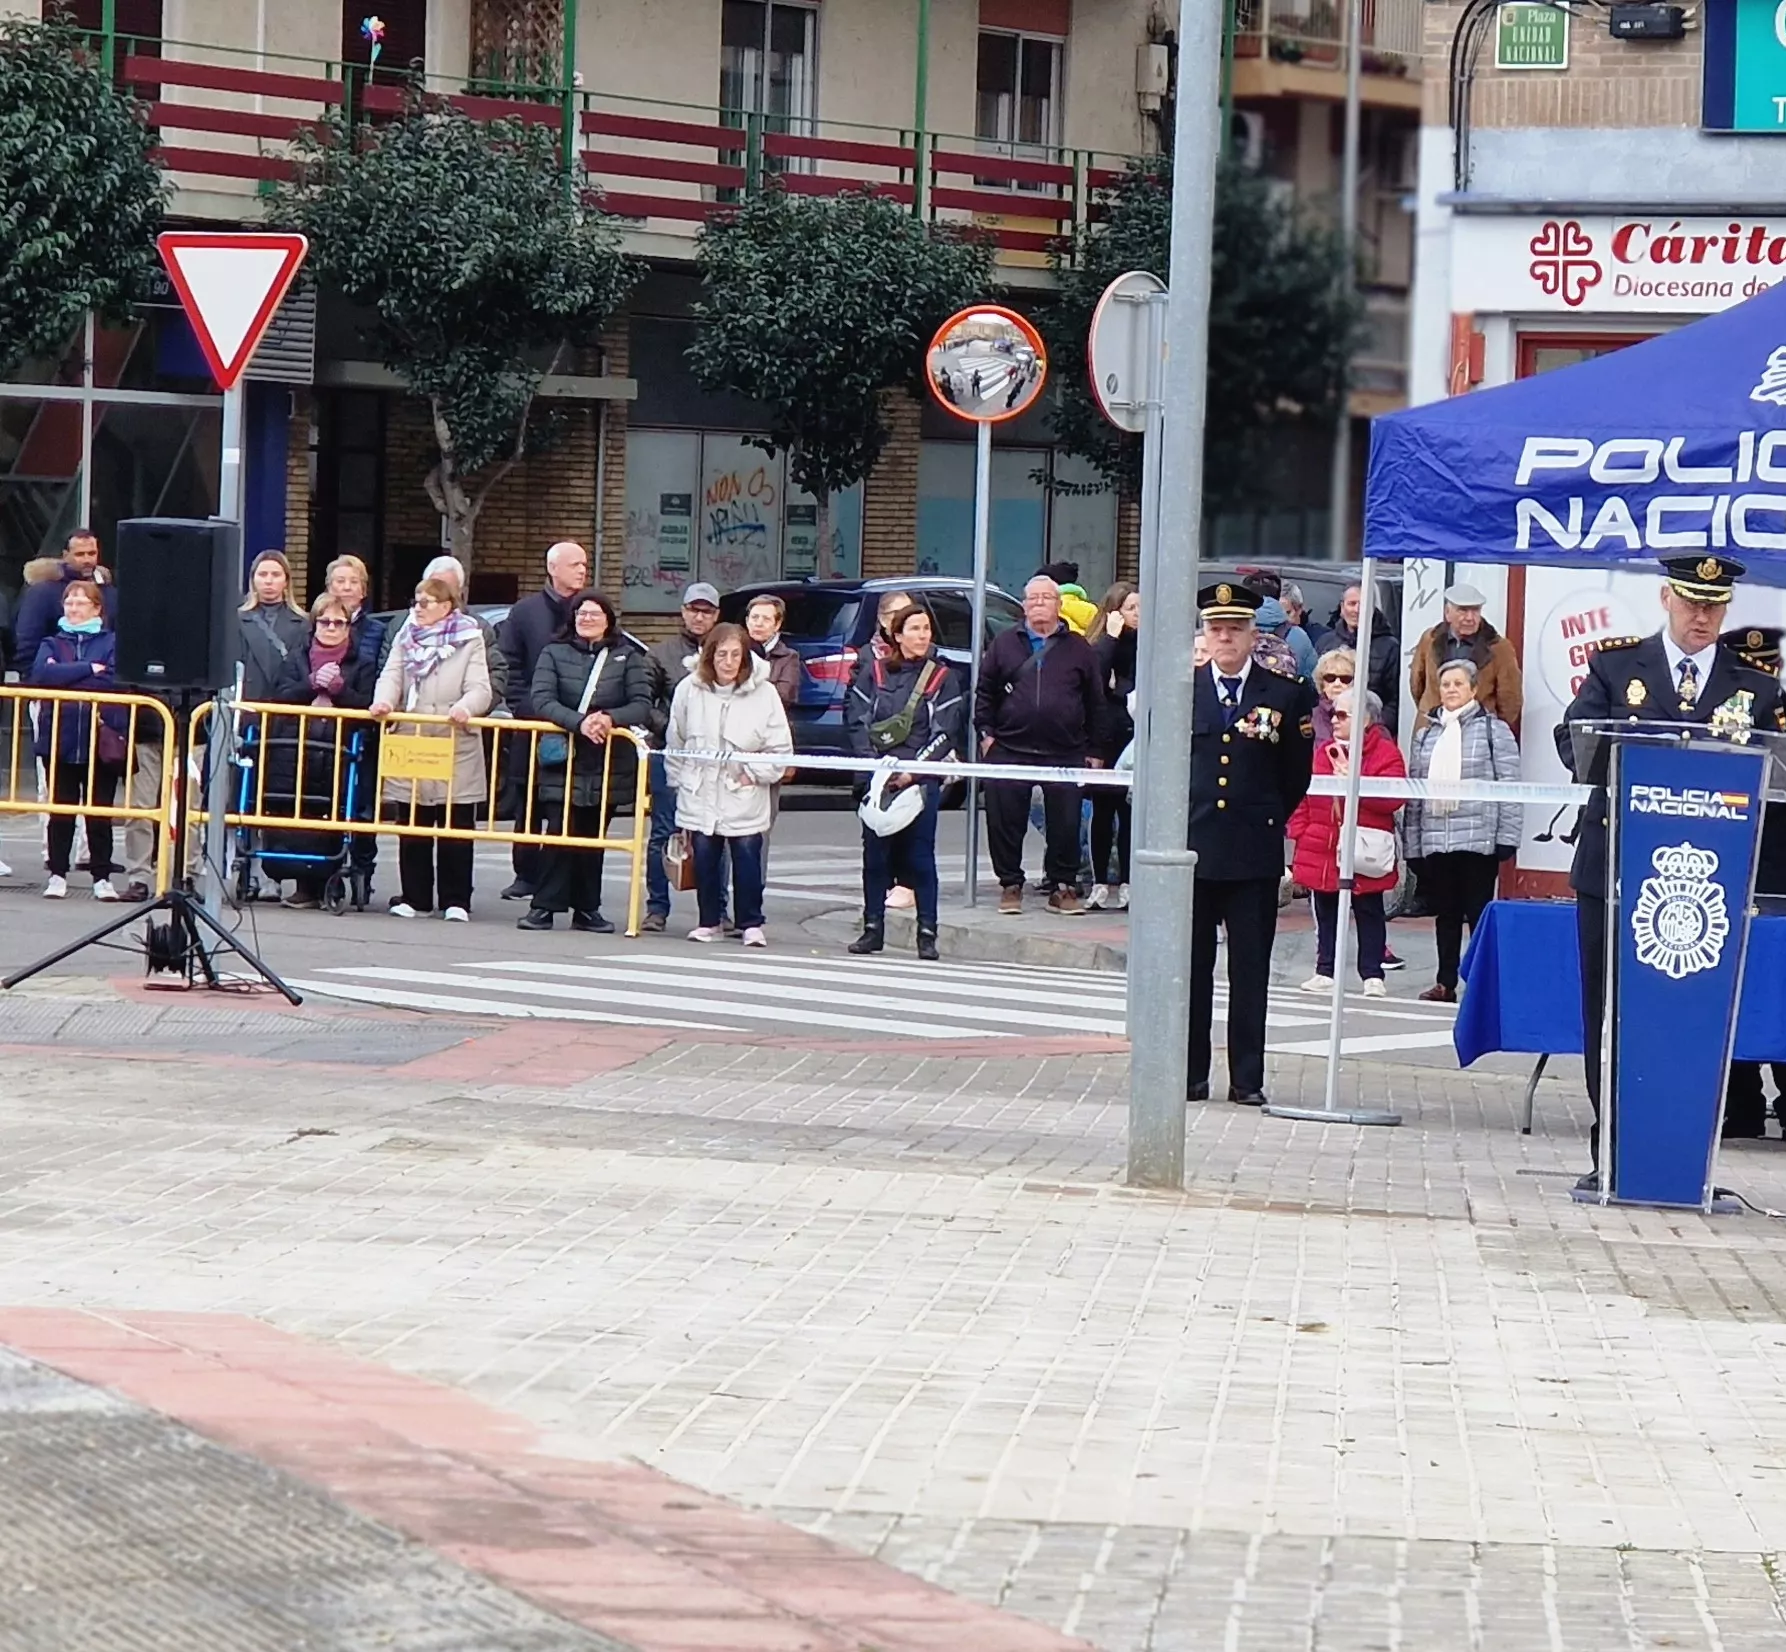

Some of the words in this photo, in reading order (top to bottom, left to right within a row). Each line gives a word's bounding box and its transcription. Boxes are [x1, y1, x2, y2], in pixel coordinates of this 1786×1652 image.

[1528, 9, 1556, 24] Plaza
[1512, 26, 1551, 43] UNIDAD
[1506, 45, 1557, 63] NACIONAL
[1614, 273, 1733, 298] Diocesana
[1561, 606, 1612, 639] INTE
[1631, 785, 1725, 804] POLICIA
[1630, 799, 1748, 820] NACIONAL
